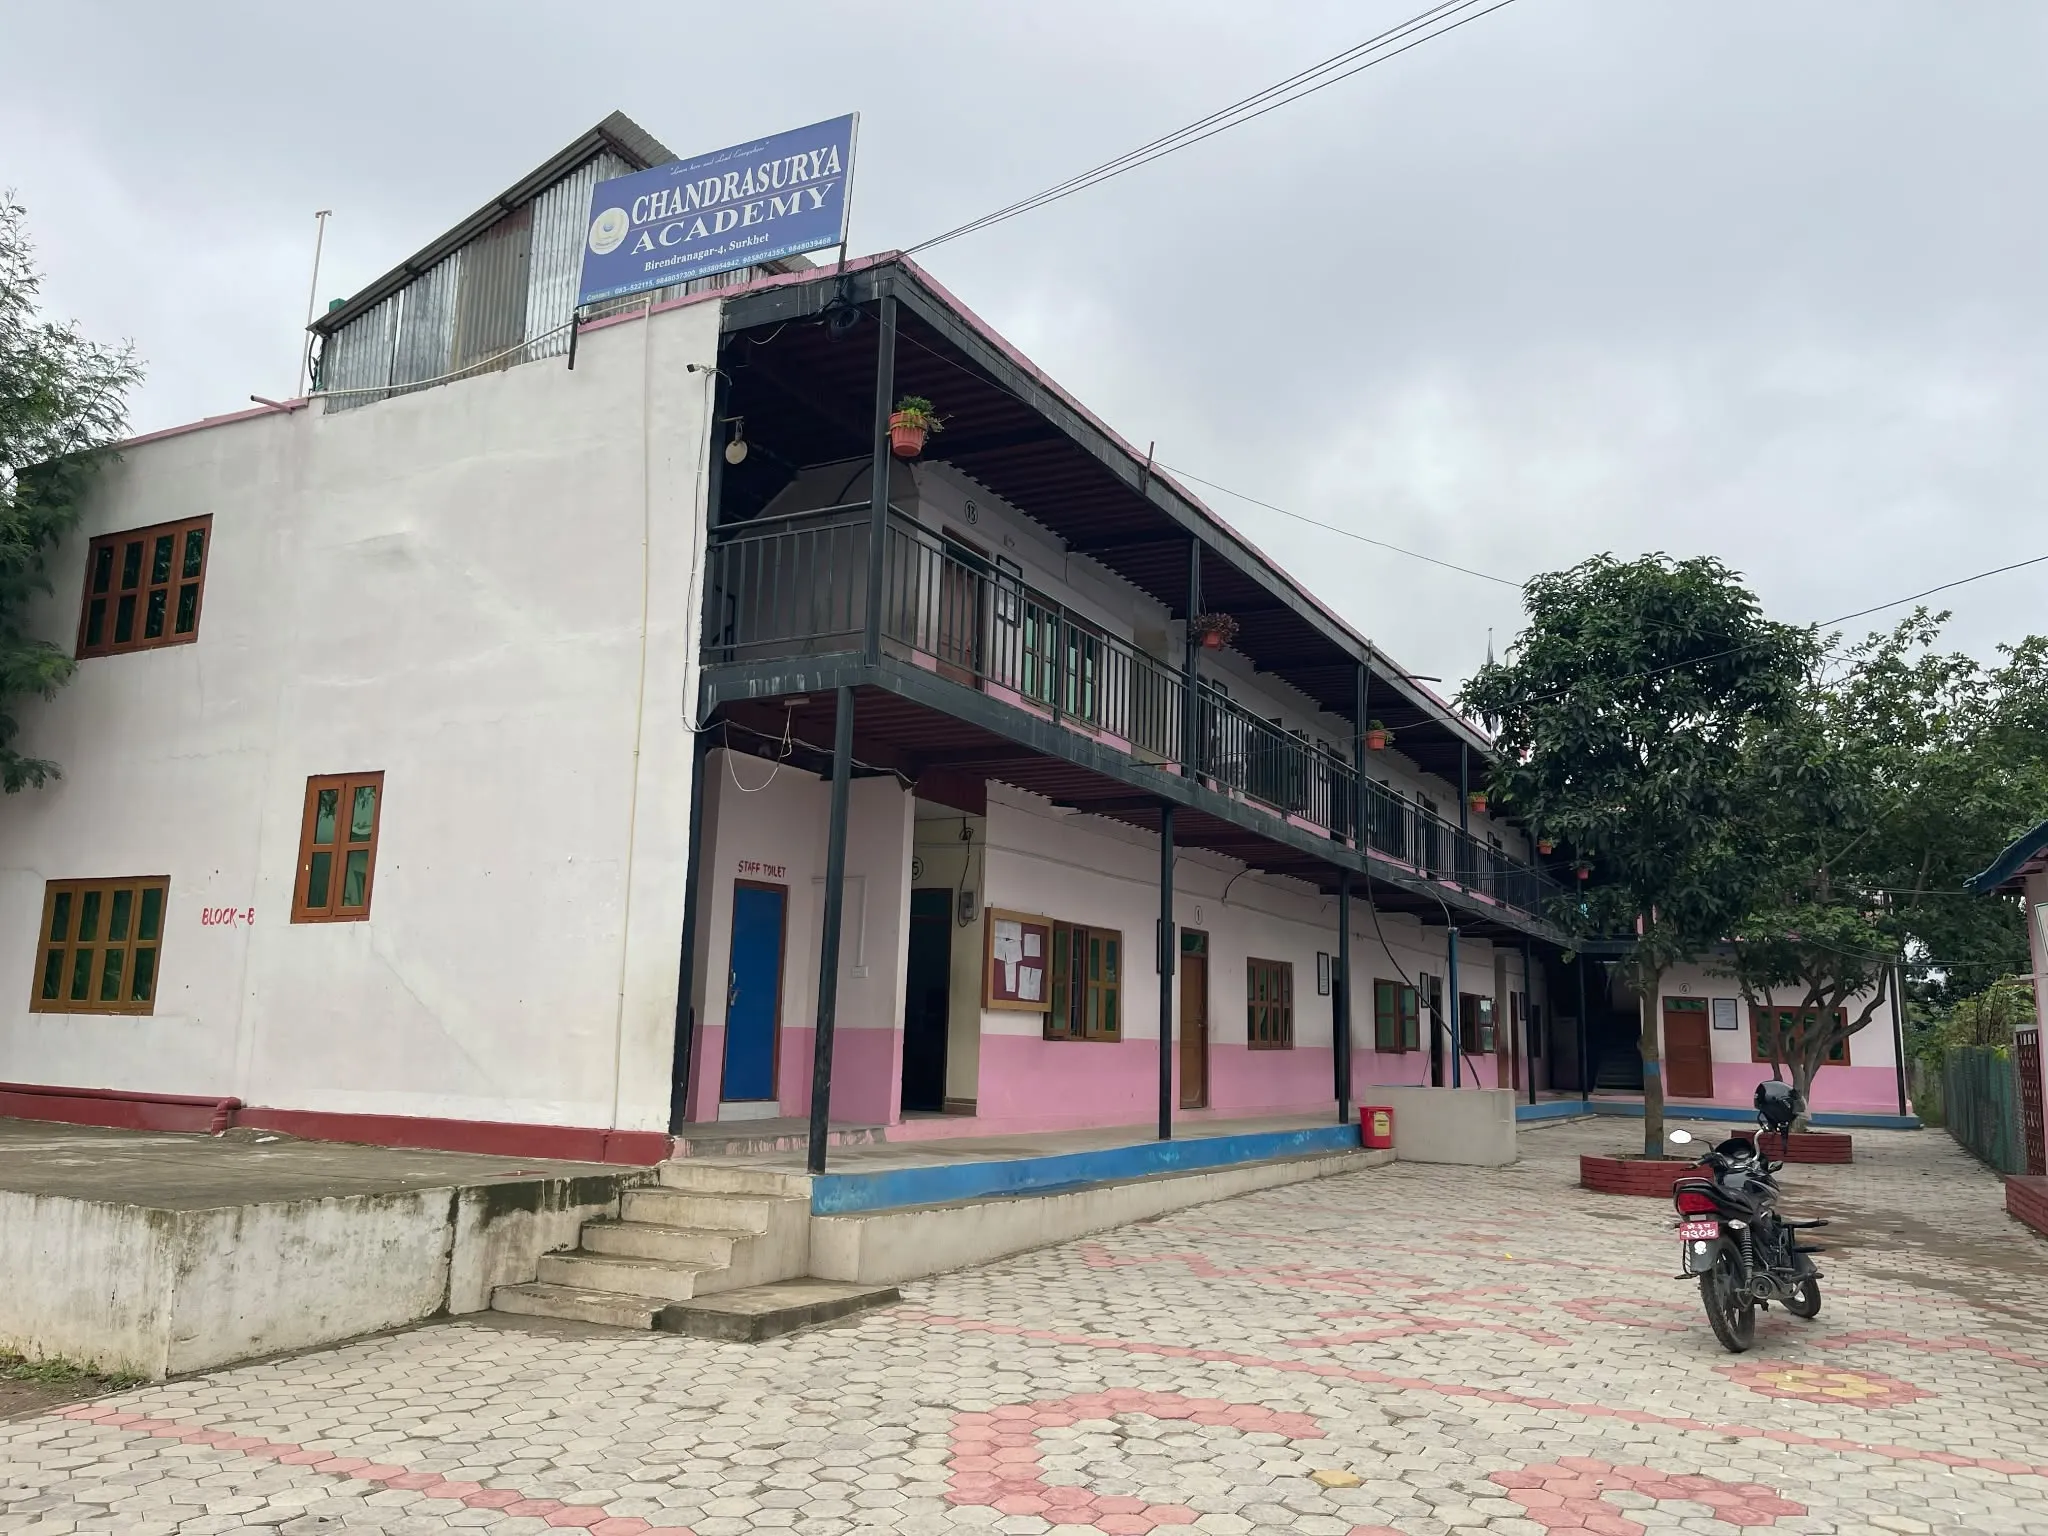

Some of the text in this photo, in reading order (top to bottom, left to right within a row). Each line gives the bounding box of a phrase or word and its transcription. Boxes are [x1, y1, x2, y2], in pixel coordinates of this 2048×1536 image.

[631, 144, 842, 225] CHANDRASURYA
[630, 183, 835, 255] ACADEMY
[729, 233, 769, 251] Surkhet
[738, 860, 787, 878] STAFF TOILET
